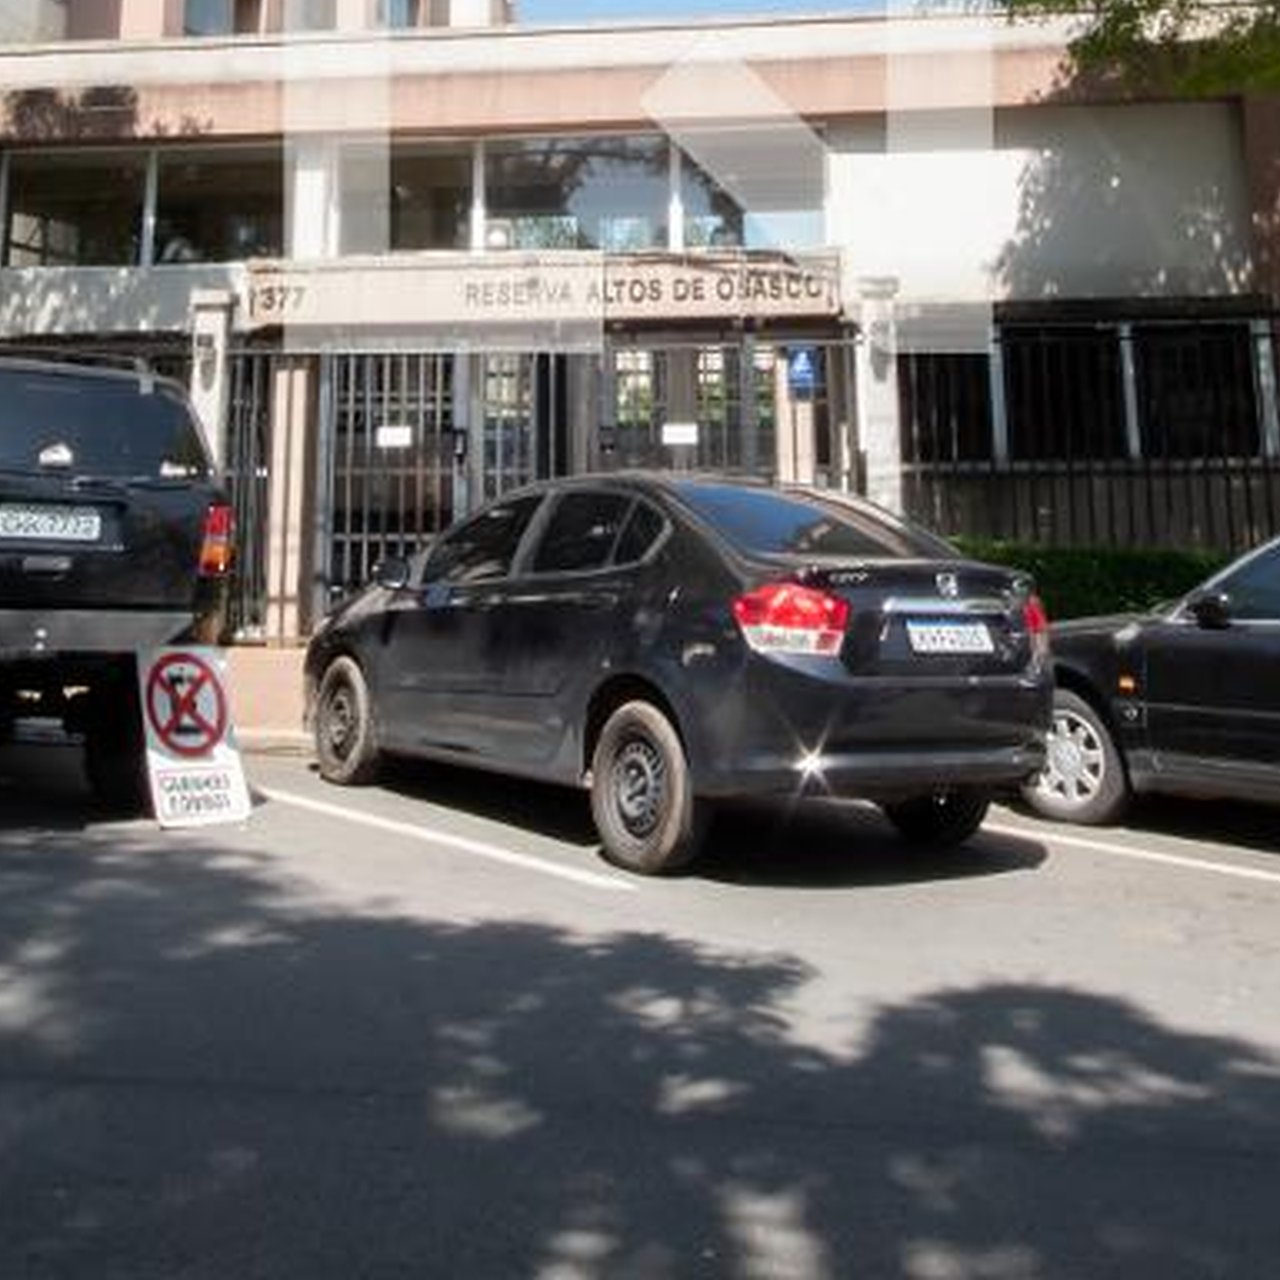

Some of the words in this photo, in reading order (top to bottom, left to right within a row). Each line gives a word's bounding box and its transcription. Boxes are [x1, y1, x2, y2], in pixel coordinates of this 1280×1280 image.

[465, 278, 571, 307] RESERVA
[586, 277, 663, 304] ALTOS
[673, 277, 706, 303] DE
